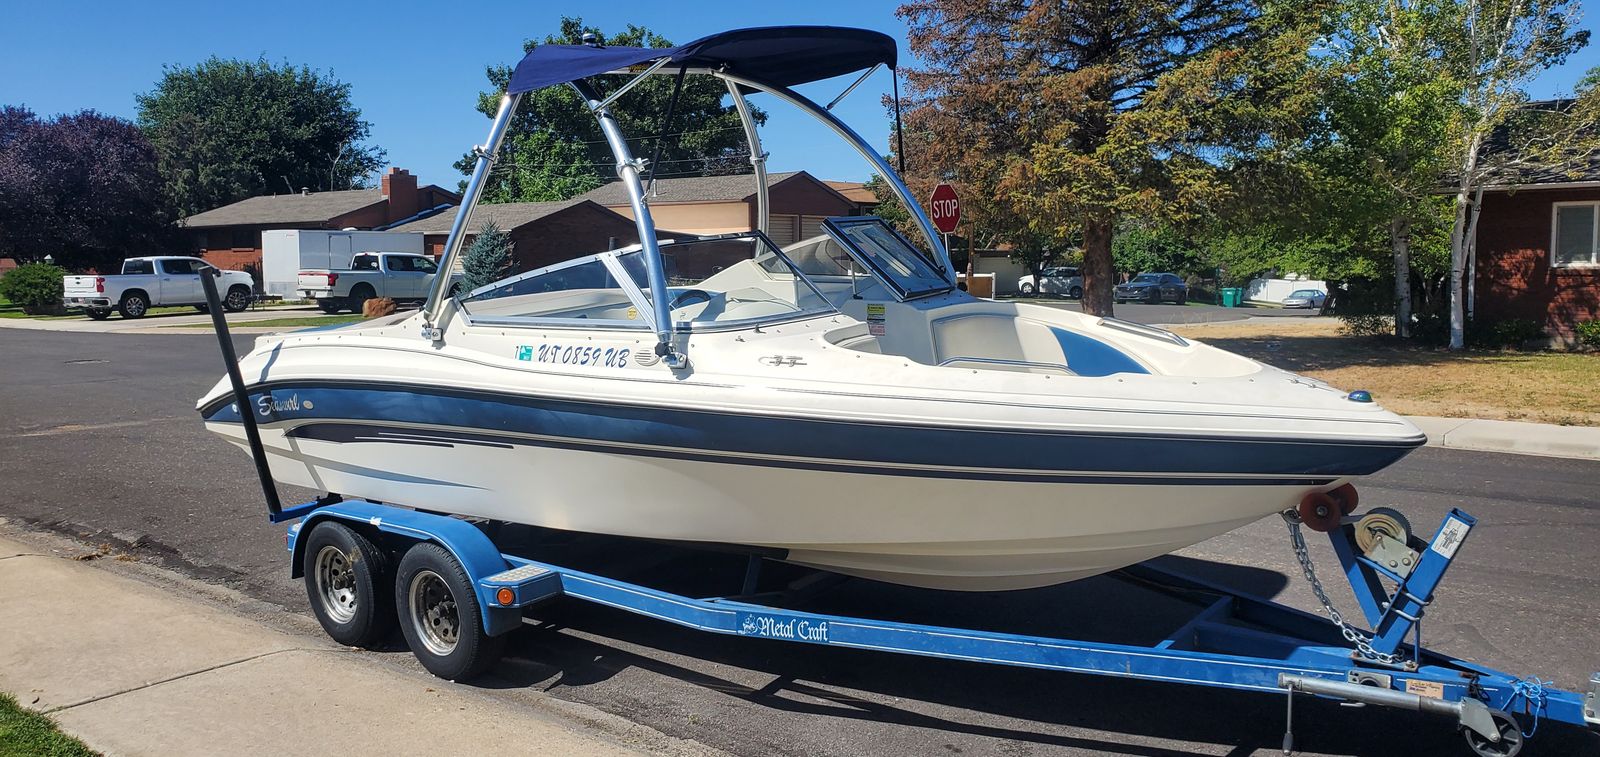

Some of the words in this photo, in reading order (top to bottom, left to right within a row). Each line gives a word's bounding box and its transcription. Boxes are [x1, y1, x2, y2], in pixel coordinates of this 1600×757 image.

[933, 199, 958, 219] STOP
[538, 344, 563, 363] UT
[562, 346, 602, 367] 0859
[605, 347, 631, 368] UB
[756, 617, 796, 638] Metal
[797, 619, 828, 641] Craft
